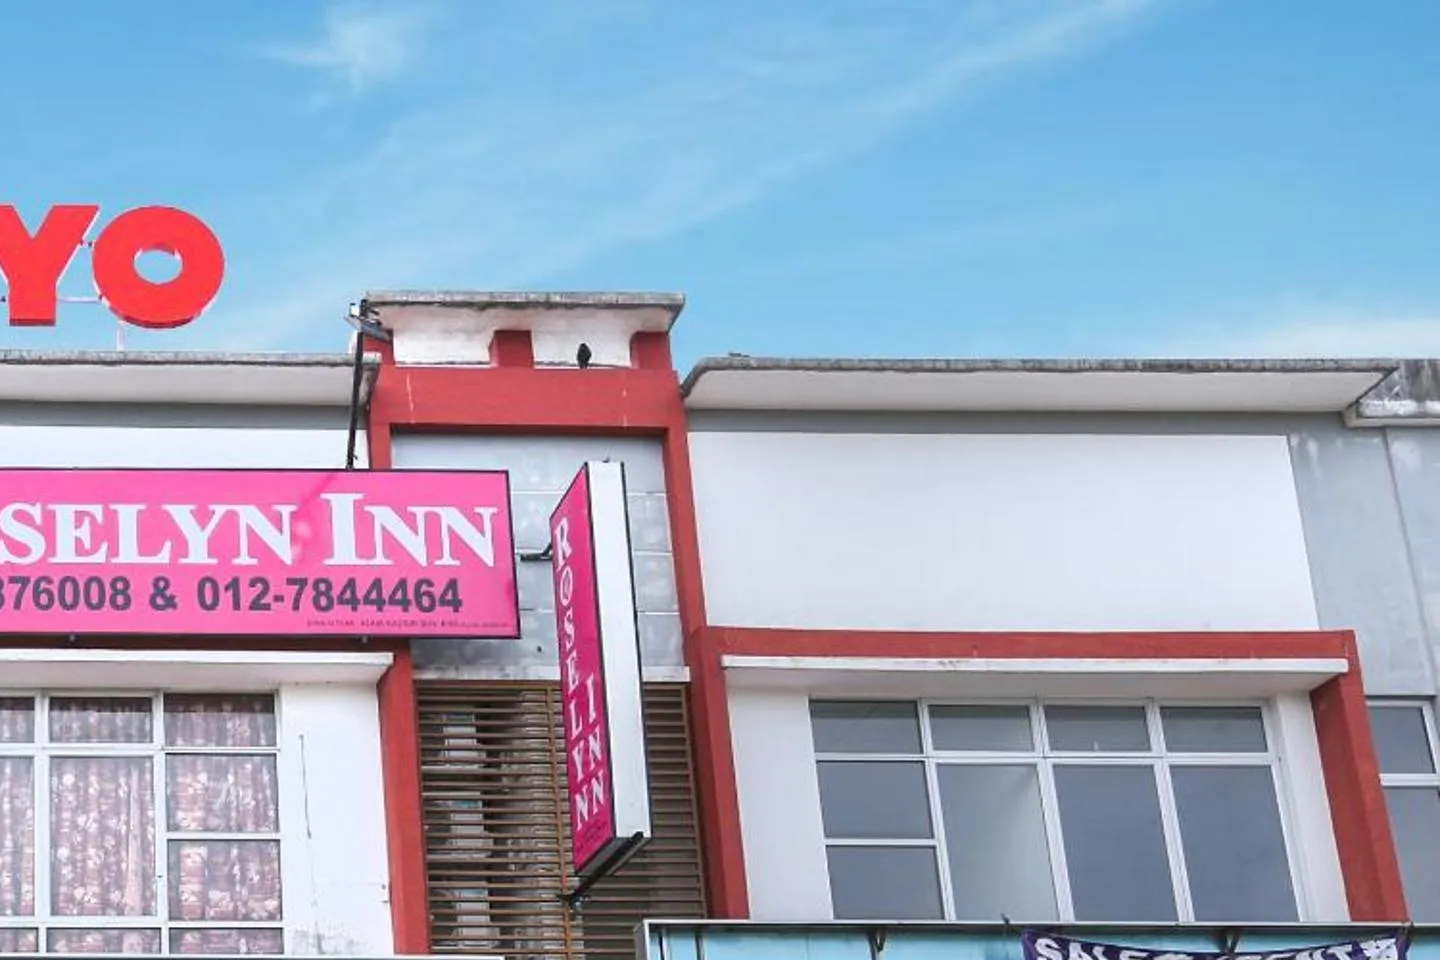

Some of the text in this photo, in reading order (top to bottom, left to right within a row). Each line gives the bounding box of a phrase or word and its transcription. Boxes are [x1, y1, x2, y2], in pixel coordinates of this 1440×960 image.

[320, 492, 498, 567] INN
[148, 575, 178, 611] &
[197, 576, 463, 613] 012-7844464
[554, 513, 591, 831] ROSELYN
